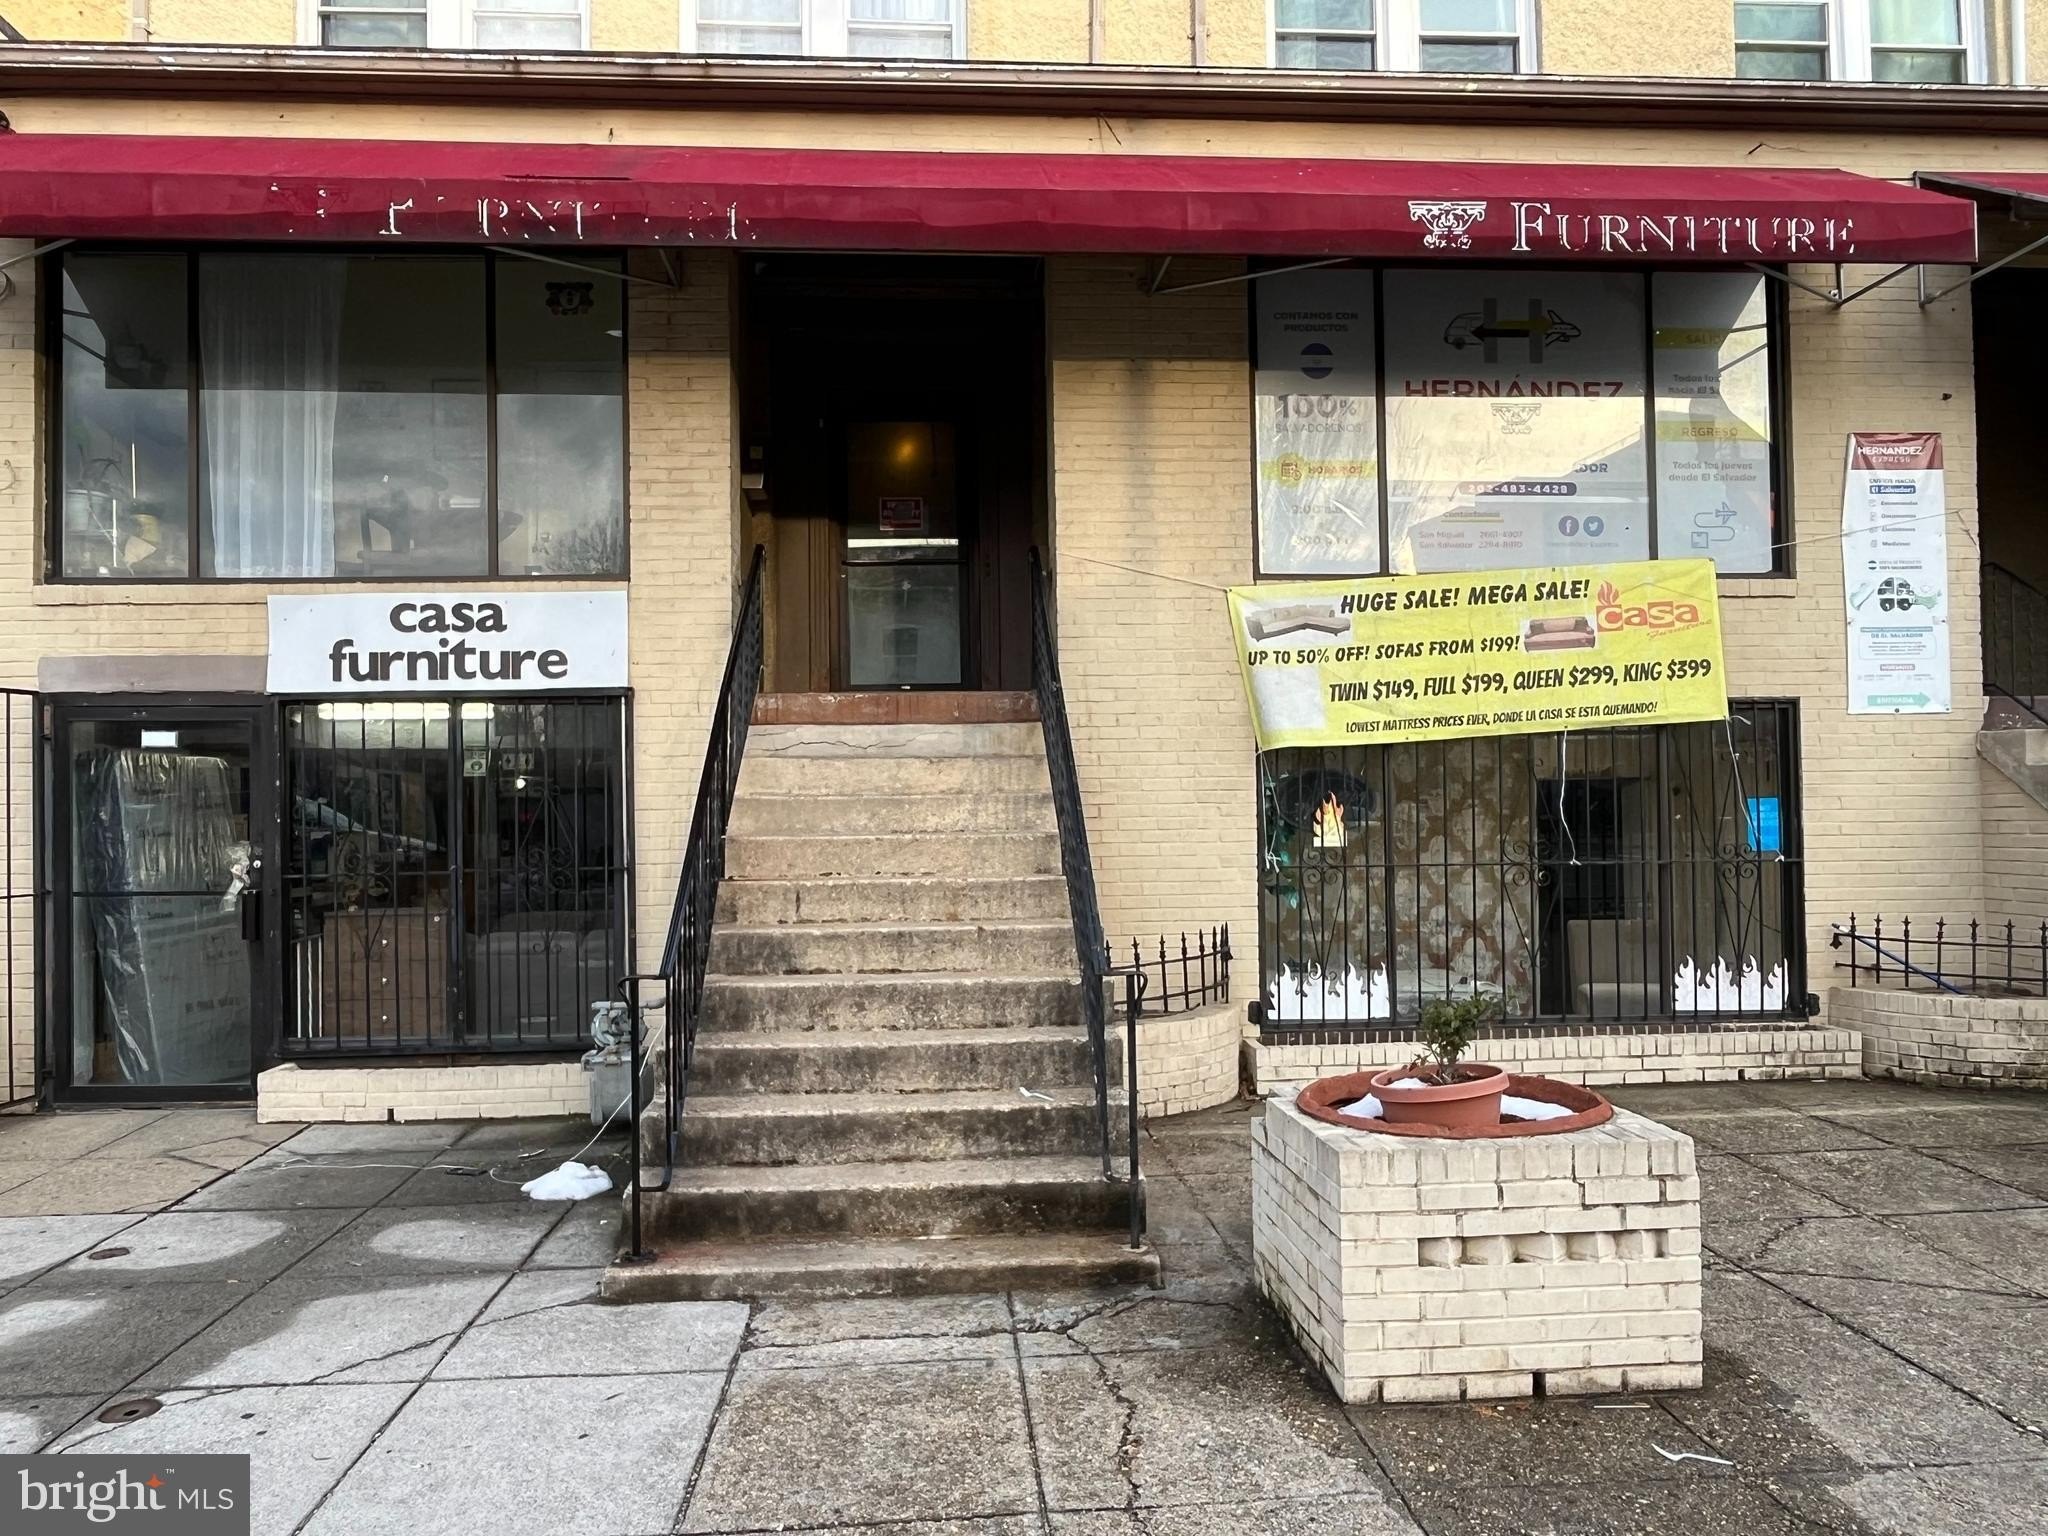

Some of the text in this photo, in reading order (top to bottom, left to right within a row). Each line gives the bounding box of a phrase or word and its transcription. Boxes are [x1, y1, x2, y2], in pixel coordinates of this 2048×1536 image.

[1511, 201, 1855, 254] FURNITURE
[1273, 311, 1359, 321] CONTAMOS CON
[1283, 323, 1349, 333] PRODUCTOS
[1277, 392, 1358, 419] 100%
[1682, 426, 1739, 437] REGRESO
[1672, 461, 1702, 471] Todos
[1713, 473, 1757, 483] Salvador
[1341, 579, 1590, 614] HUGE SALE! MEGA SALE!
[389, 602, 507, 633] casa
[329, 638, 568, 682] furniture
[1248, 635, 1521, 666] UP TO 50% OFF! SOFAS FROM $199!
[1330, 658, 1712, 702] TWIN $149, FULL $199, QUEEN $299, KING $399
[1346, 701, 1658, 733] LOWEST MATTRESS PRICES EVER, DONDE LA CASA SE ESTA QUEMANDO!
